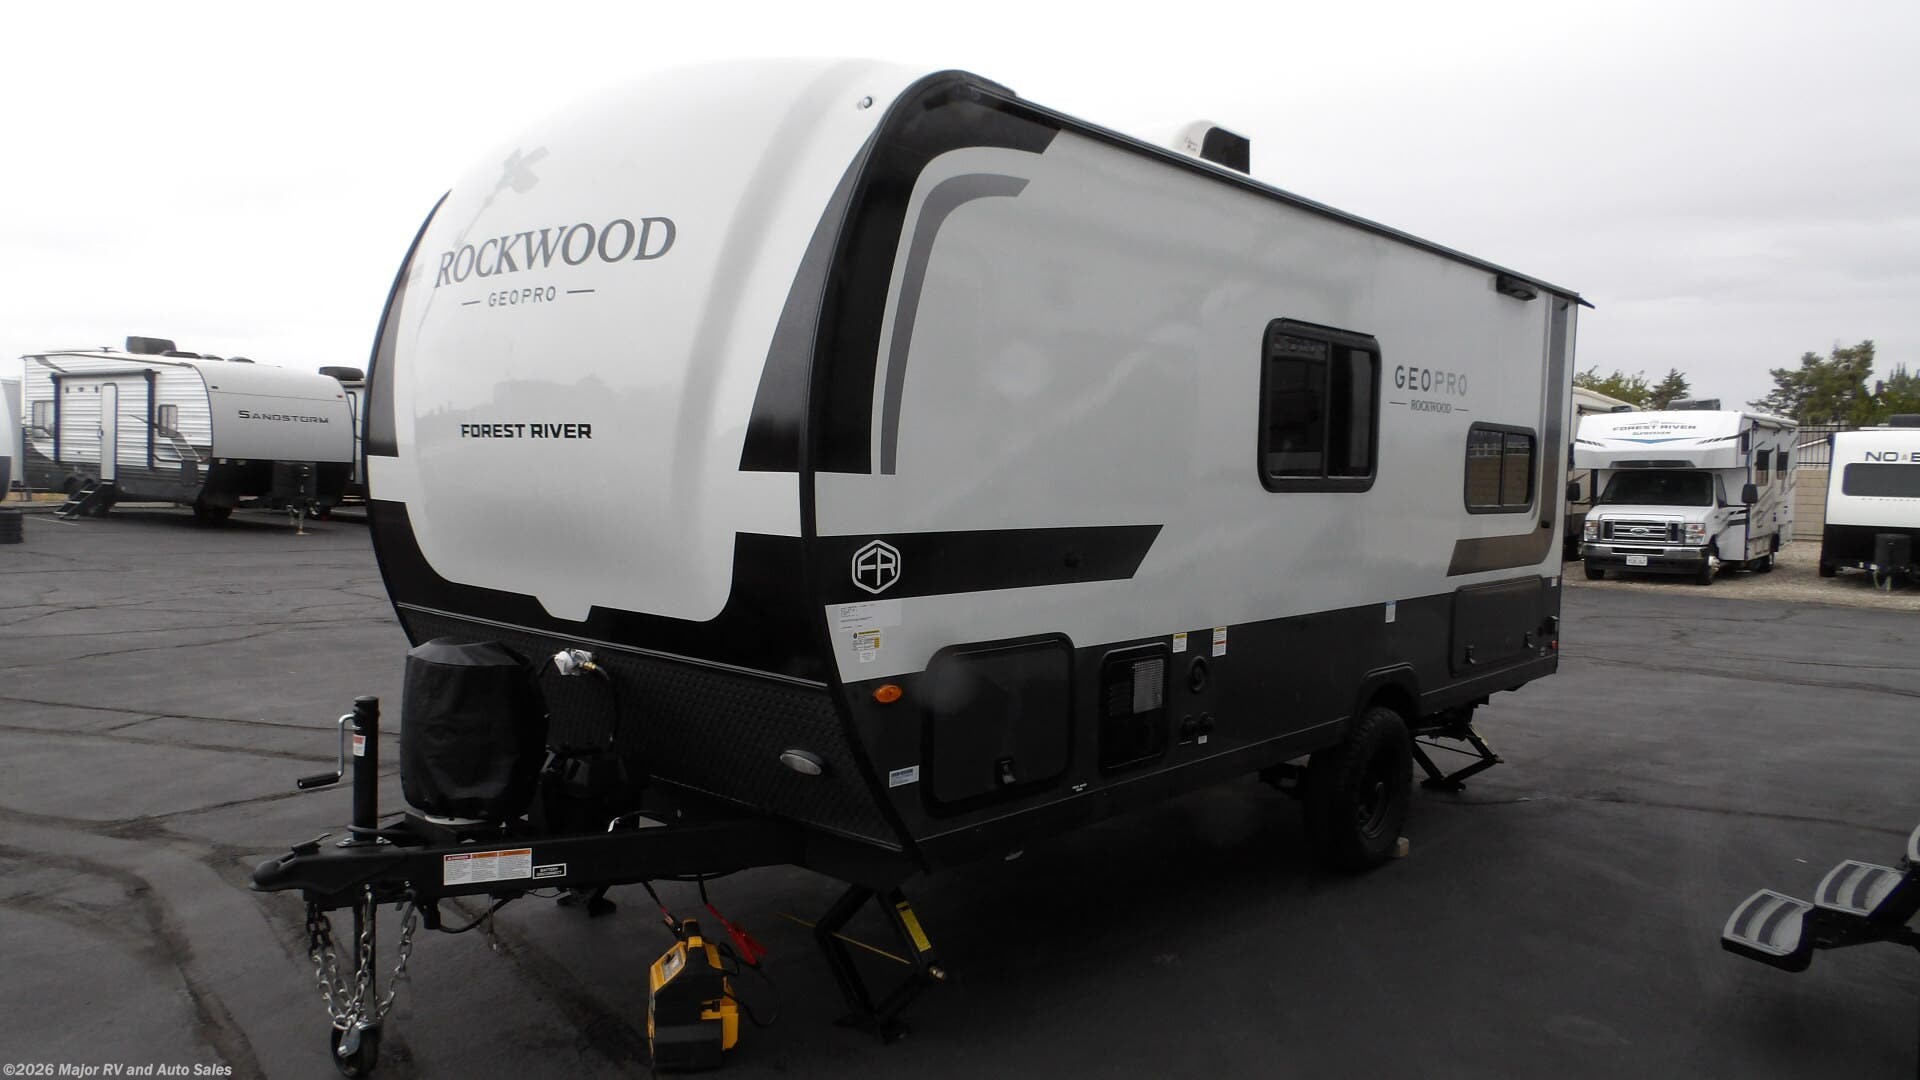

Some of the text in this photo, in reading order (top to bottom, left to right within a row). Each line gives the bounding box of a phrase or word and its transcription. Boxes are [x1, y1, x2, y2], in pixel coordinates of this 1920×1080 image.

[434, 216, 677, 288] ROCKWOOD
[487, 285, 556, 308] GEOPRO
[1394, 364, 1468, 397] GEOPRO
[1410, 399, 1452, 414] ROCKWOOD
[460, 423, 593, 440] FOREST RIVER
[1612, 424, 1657, 432] FOREST
